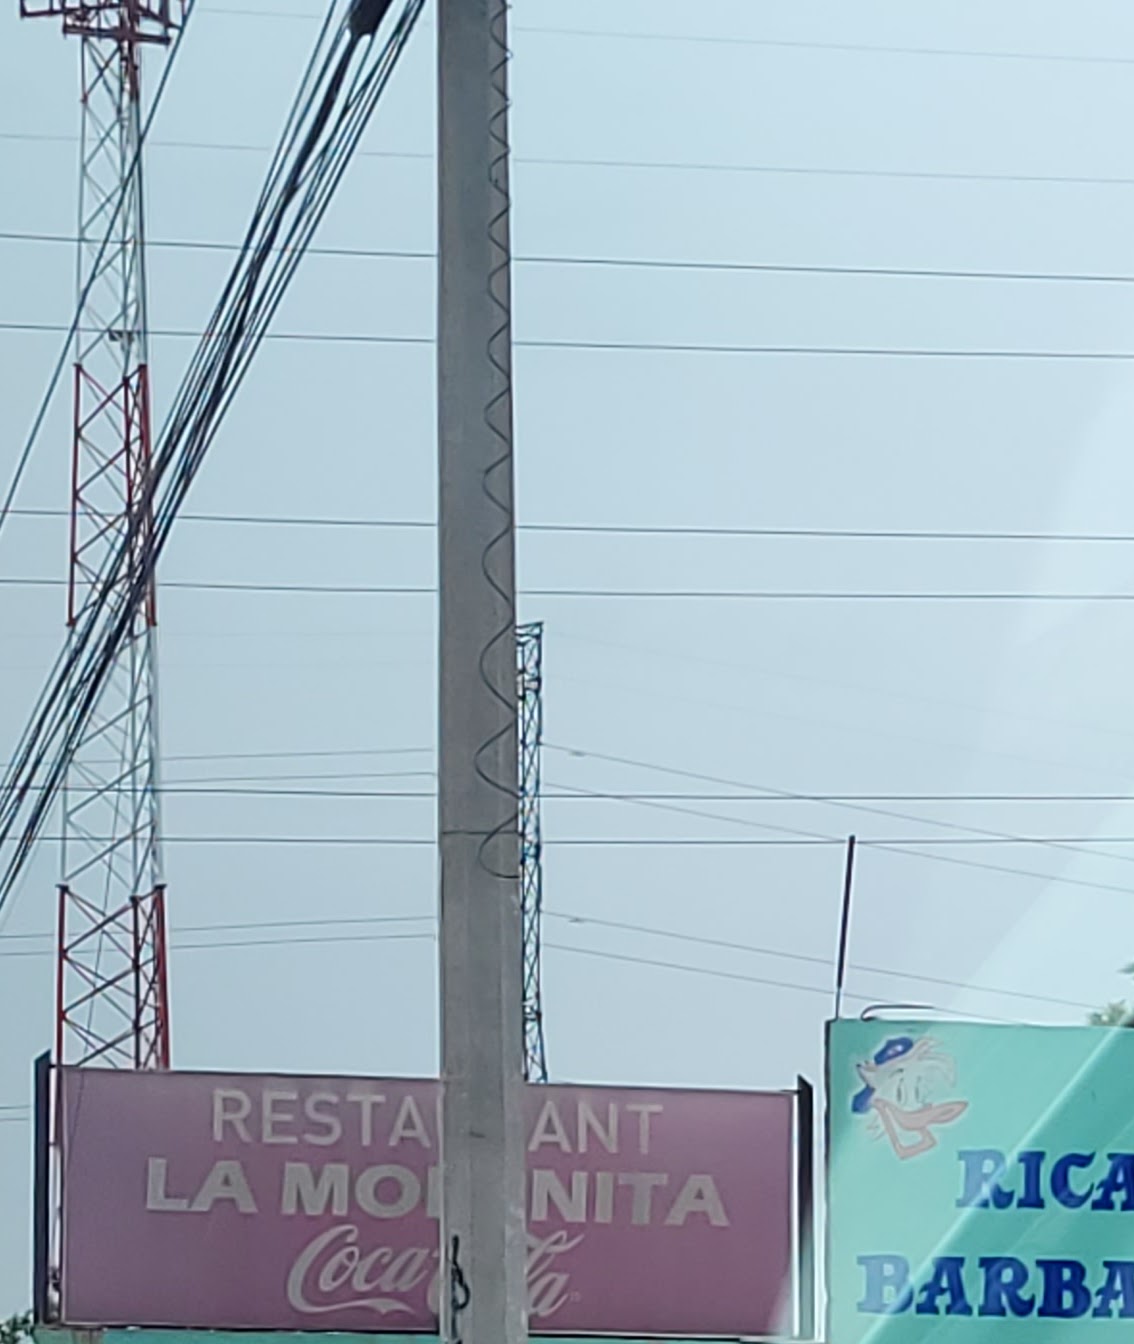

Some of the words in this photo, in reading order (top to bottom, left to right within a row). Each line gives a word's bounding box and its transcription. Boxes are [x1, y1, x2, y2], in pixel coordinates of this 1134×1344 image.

[210, 1088, 664, 1155] RESTAANT
[145, 1156, 258, 1214] LA
[280, 1161, 729, 1228] MONITA
